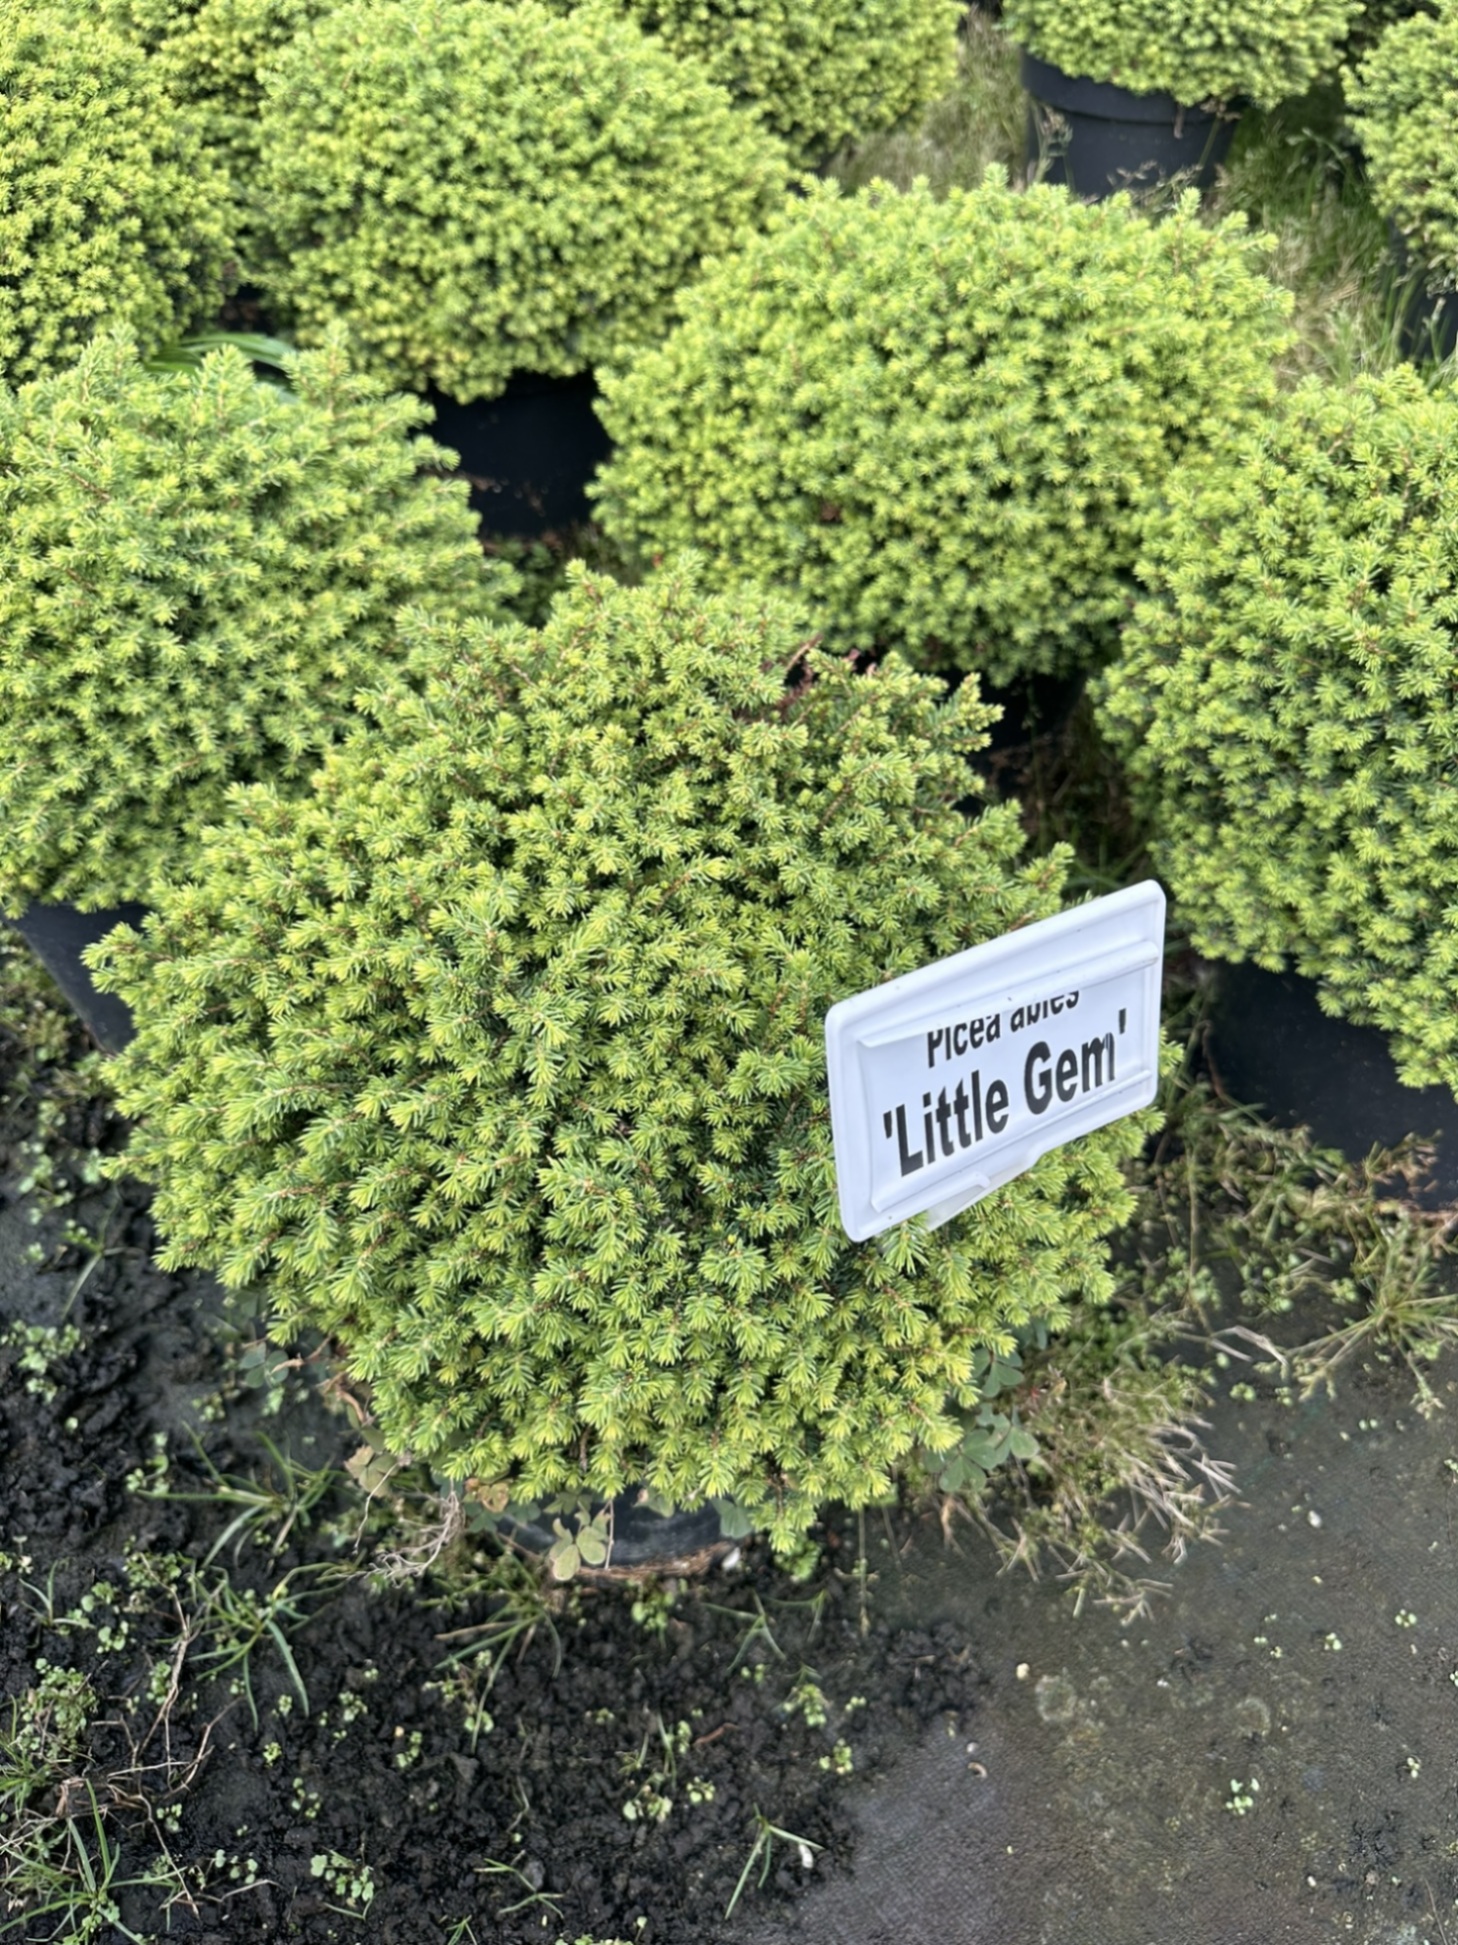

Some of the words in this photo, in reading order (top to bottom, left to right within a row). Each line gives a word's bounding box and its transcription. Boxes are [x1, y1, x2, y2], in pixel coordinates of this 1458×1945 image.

[883, 1069, 1009, 1177] 'Little
[1024, 1008, 1126, 1115] Gem'
[927, 1012, 1001, 1069] Picea
